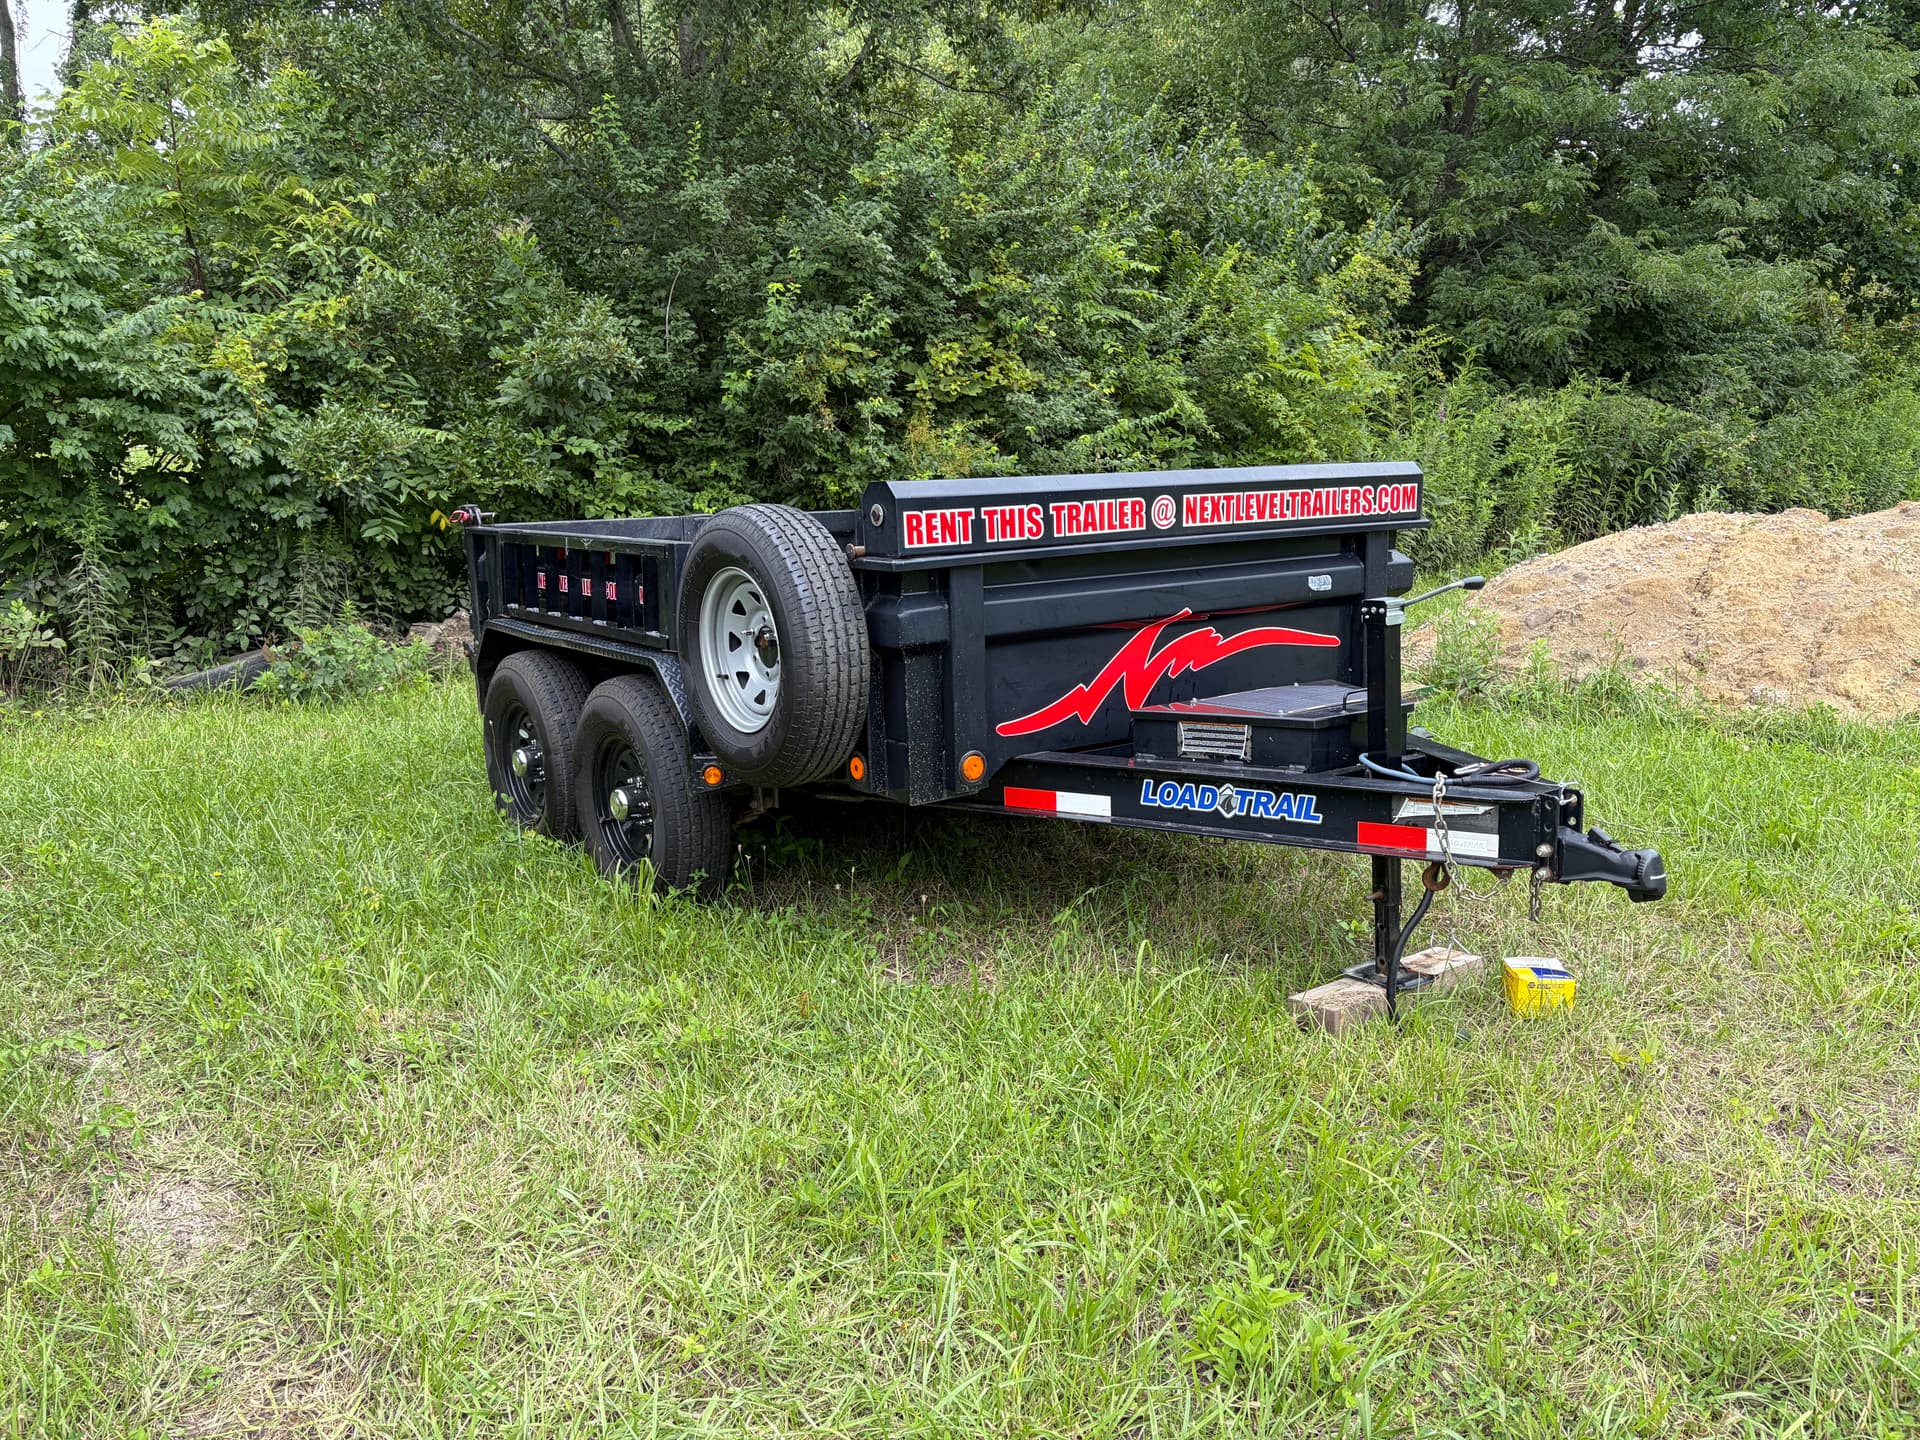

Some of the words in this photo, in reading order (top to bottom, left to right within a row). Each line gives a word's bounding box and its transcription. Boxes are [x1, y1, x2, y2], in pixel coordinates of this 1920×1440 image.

[904, 508, 973, 549] RENT
[982, 503, 1044, 542] THIS
[1051, 497, 1146, 536] TRAILER
[1150, 494, 1177, 529] @
[1183, 484, 1418, 526] NEXTLEVELTRAILERS.COM
[1140, 778, 1220, 813] LOAD
[1233, 787, 1324, 824] TRAIL
